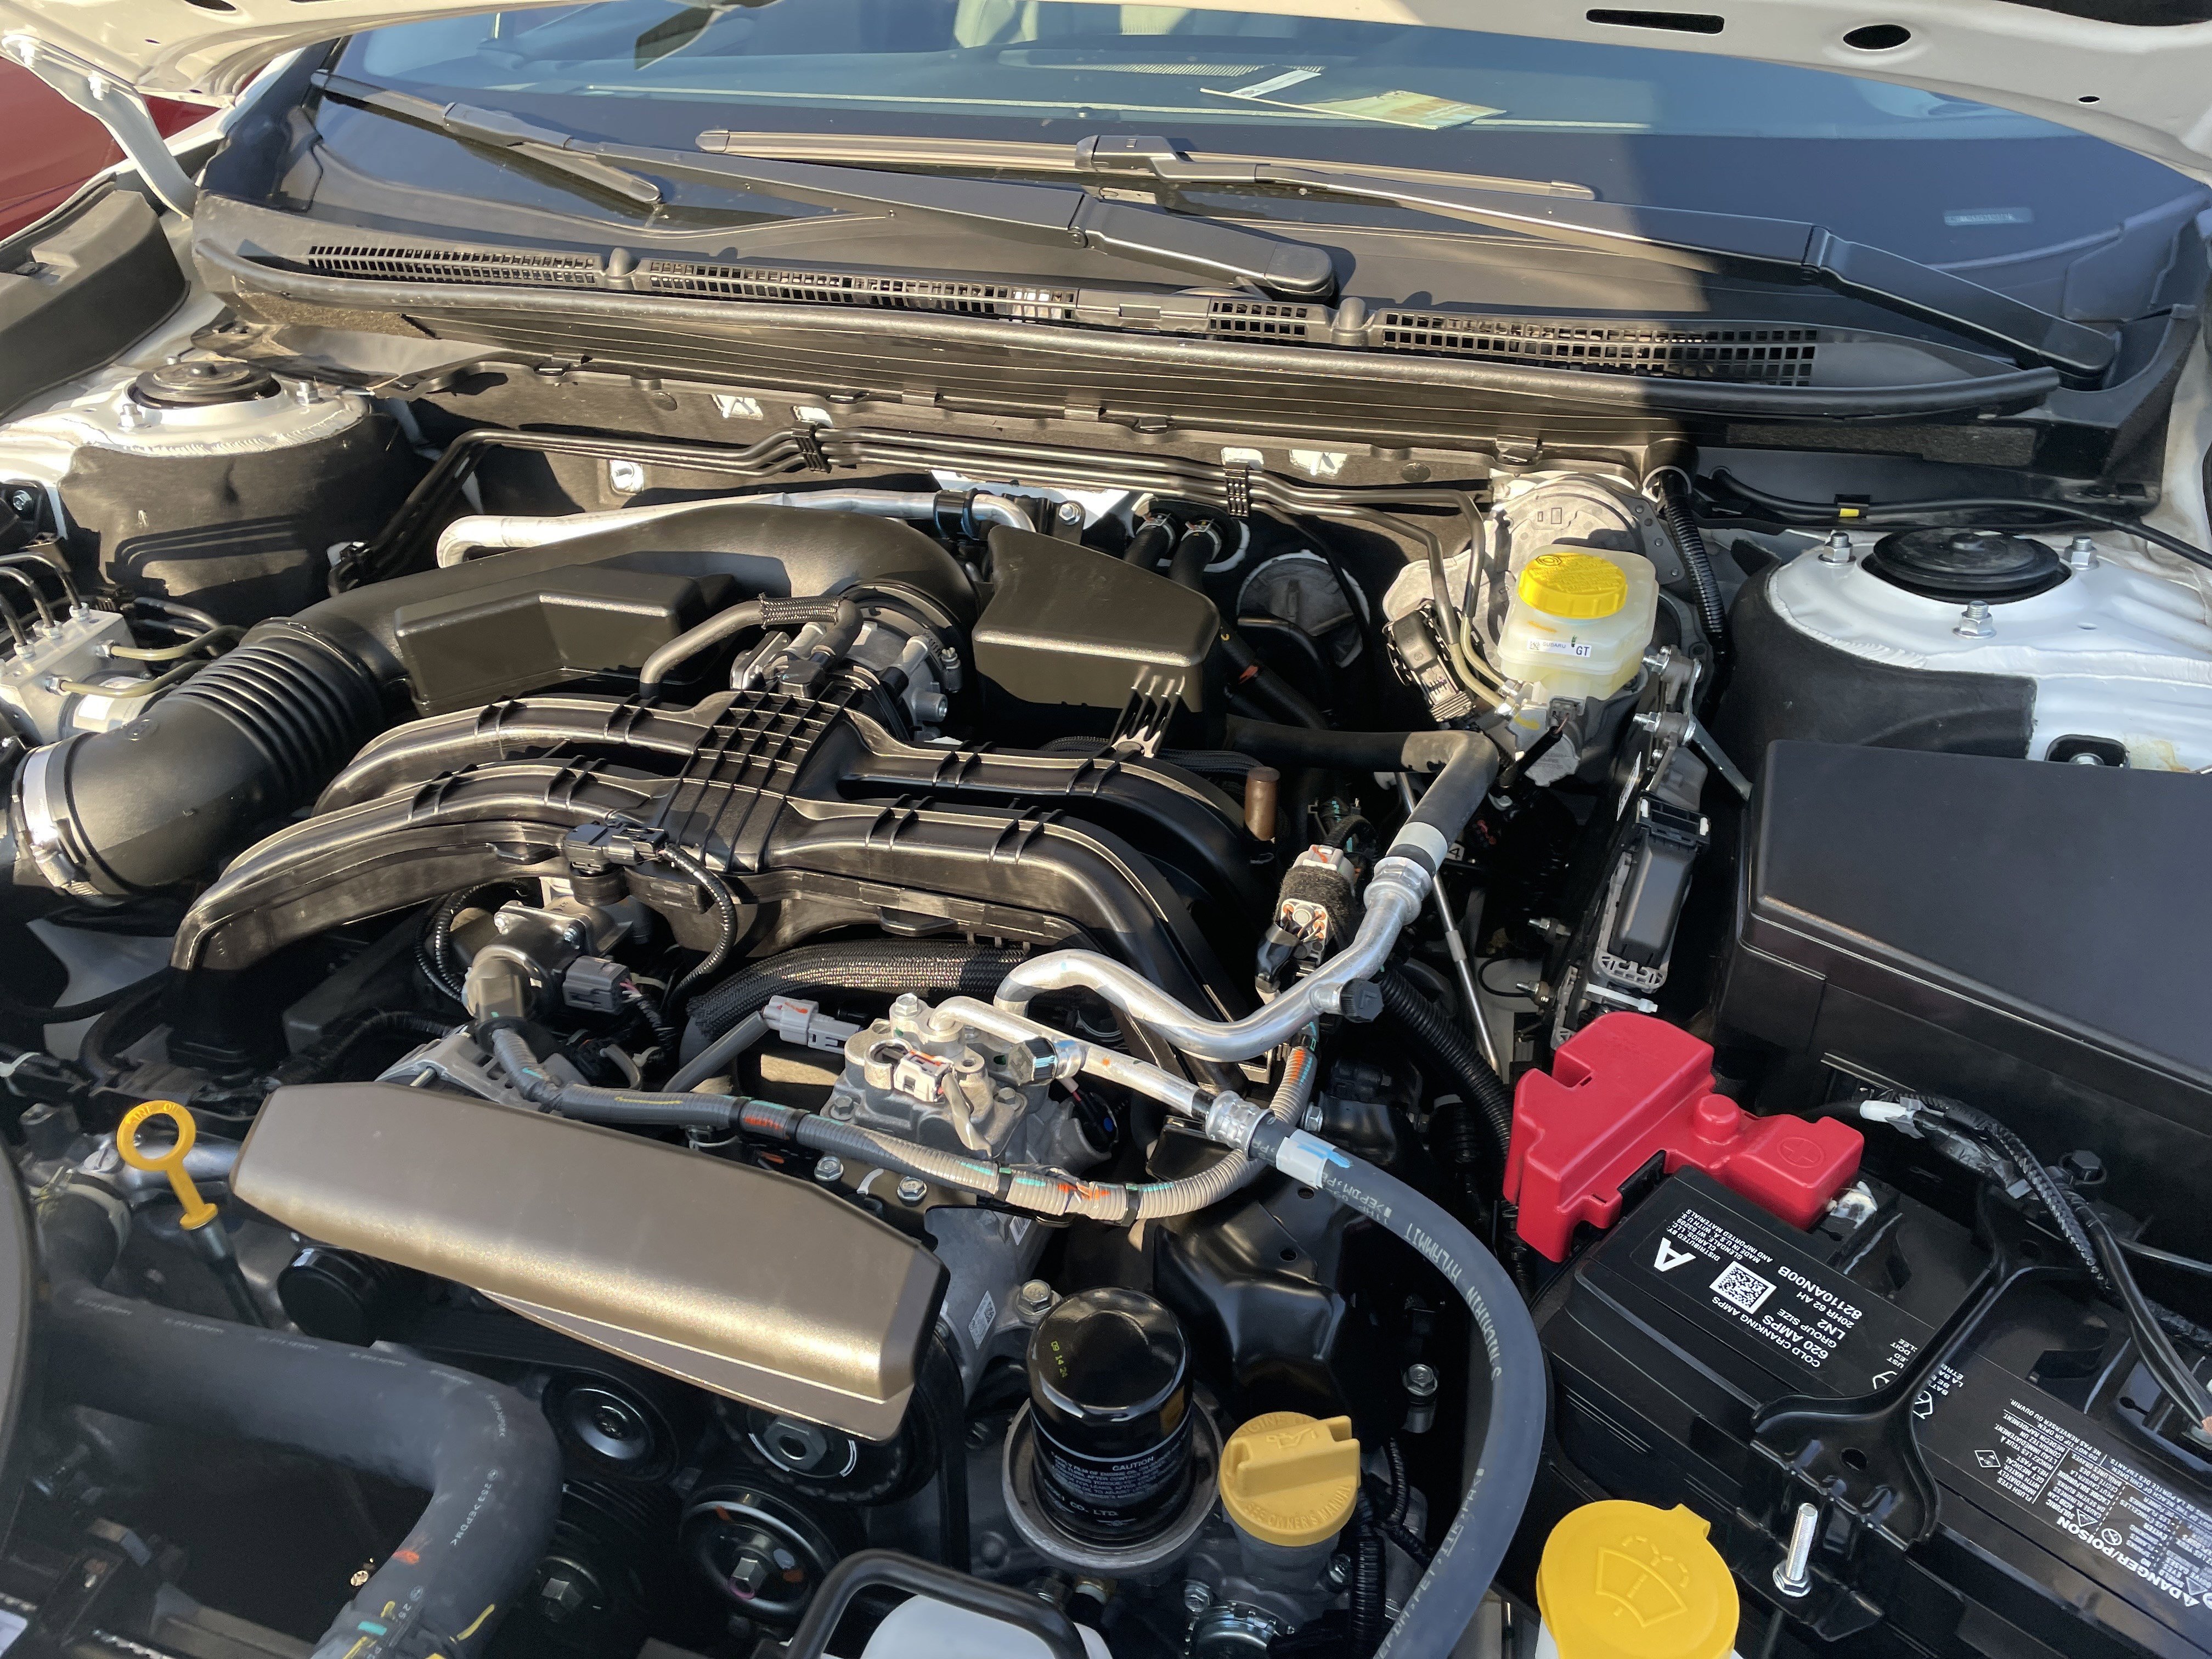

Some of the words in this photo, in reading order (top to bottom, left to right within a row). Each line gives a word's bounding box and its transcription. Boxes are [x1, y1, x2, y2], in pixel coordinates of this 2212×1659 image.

[1576, 646, 1590, 656] GT
[1676, 1217, 1697, 1232] 53209
[1685, 1208, 1723, 1233] MATERIALS
[1692, 1220, 1712, 1234] WITH
[1696, 1229, 1707, 1238] WI
[1677, 1232, 1720, 1261] DISTRIBUTED
[1722, 1230, 1757, 1254] IMPORTED
[1739, 1248, 1761, 1263] MADE
[1757, 1251, 1773, 1263] AND
[1776, 1265, 1863, 1320] 82110AN00B
[1796, 1290, 1814, 1304] AH
[1710, 1295, 1741, 1317] AMPS
[1812, 1300, 1827, 1312] 62
[1776, 1308, 1801, 1326] SIZE
[1825, 1308, 1855, 1329] 20HR
[1738, 1313, 1792, 1350] CRANKING
[1760, 1313, 1804, 1344] AMPS
[1798, 1322, 1838, 1349] GROUP
[1815, 1317, 1846, 1340] LN2
[1801, 1339, 1830, 1360] 620
[1889, 1341, 1911, 1356] DOIT
[1790, 1346, 1821, 1368] COLD
[2033, 1413, 2044, 1422] OU
[2019, 1430, 2029, 1439] UN
[2042, 1418, 2080, 1443] RENVERSER
[2053, 1432, 2064, 1442] OR
[2004, 1438, 2022, 1451] YEUX
[2028, 1435, 2062, 1459] CONSULTEZ
[2063, 1438, 2074, 1448] TIP
[2074, 1444, 2089, 1455] NOT
[2079, 1440, 2093, 1451] PAS
[2020, 1448, 2033, 1458] LES
[2087, 1452, 2098, 1461] DO
[2091, 1447, 2102, 1456] NE
[1112, 1455, 1154, 1472] CAUTION
[2004, 1455, 2032, 1476] MEDICAL
[2014, 1453, 2033, 1468] FAST.
[2031, 1454, 2053, 1470] RINCEZ
[2031, 1464, 2049, 1477] HELP
[2031, 1473, 2045, 1483] GET
[2069, 1469, 2079, 1477] LA
[2078, 1466, 2091, 1476] DES
[2090, 1473, 2100, 1481] OU
[1996, 1476, 2013, 1489] EYES
[1997, 1468, 2037, 1496] IMMEDIATELY
[2023, 1476, 2041, 1489] WITH
[2056, 1469, 2091, 1493] SULFURIQUE
[2077, 1474, 2100, 1490] CAUSER
[2011, 1486, 2033, 1502] FLUSH
[2046, 1491, 2060, 1502] CAN
[2052, 1485, 2084, 1508] BLINDNESS
[2074, 1491, 2098, 1508] SEVERE
[2098, 1487, 2115, 1499] PEUT
[2045, 1498, 2075, 1520] SULFURIC
[2058, 1498, 2074, 1510] ACID
[2083, 1504, 2102, 1519] CAUSE
[2096, 1504, 2106, 1513] OR
[2056, 1515, 2183, 1599] DANGER/POISON
